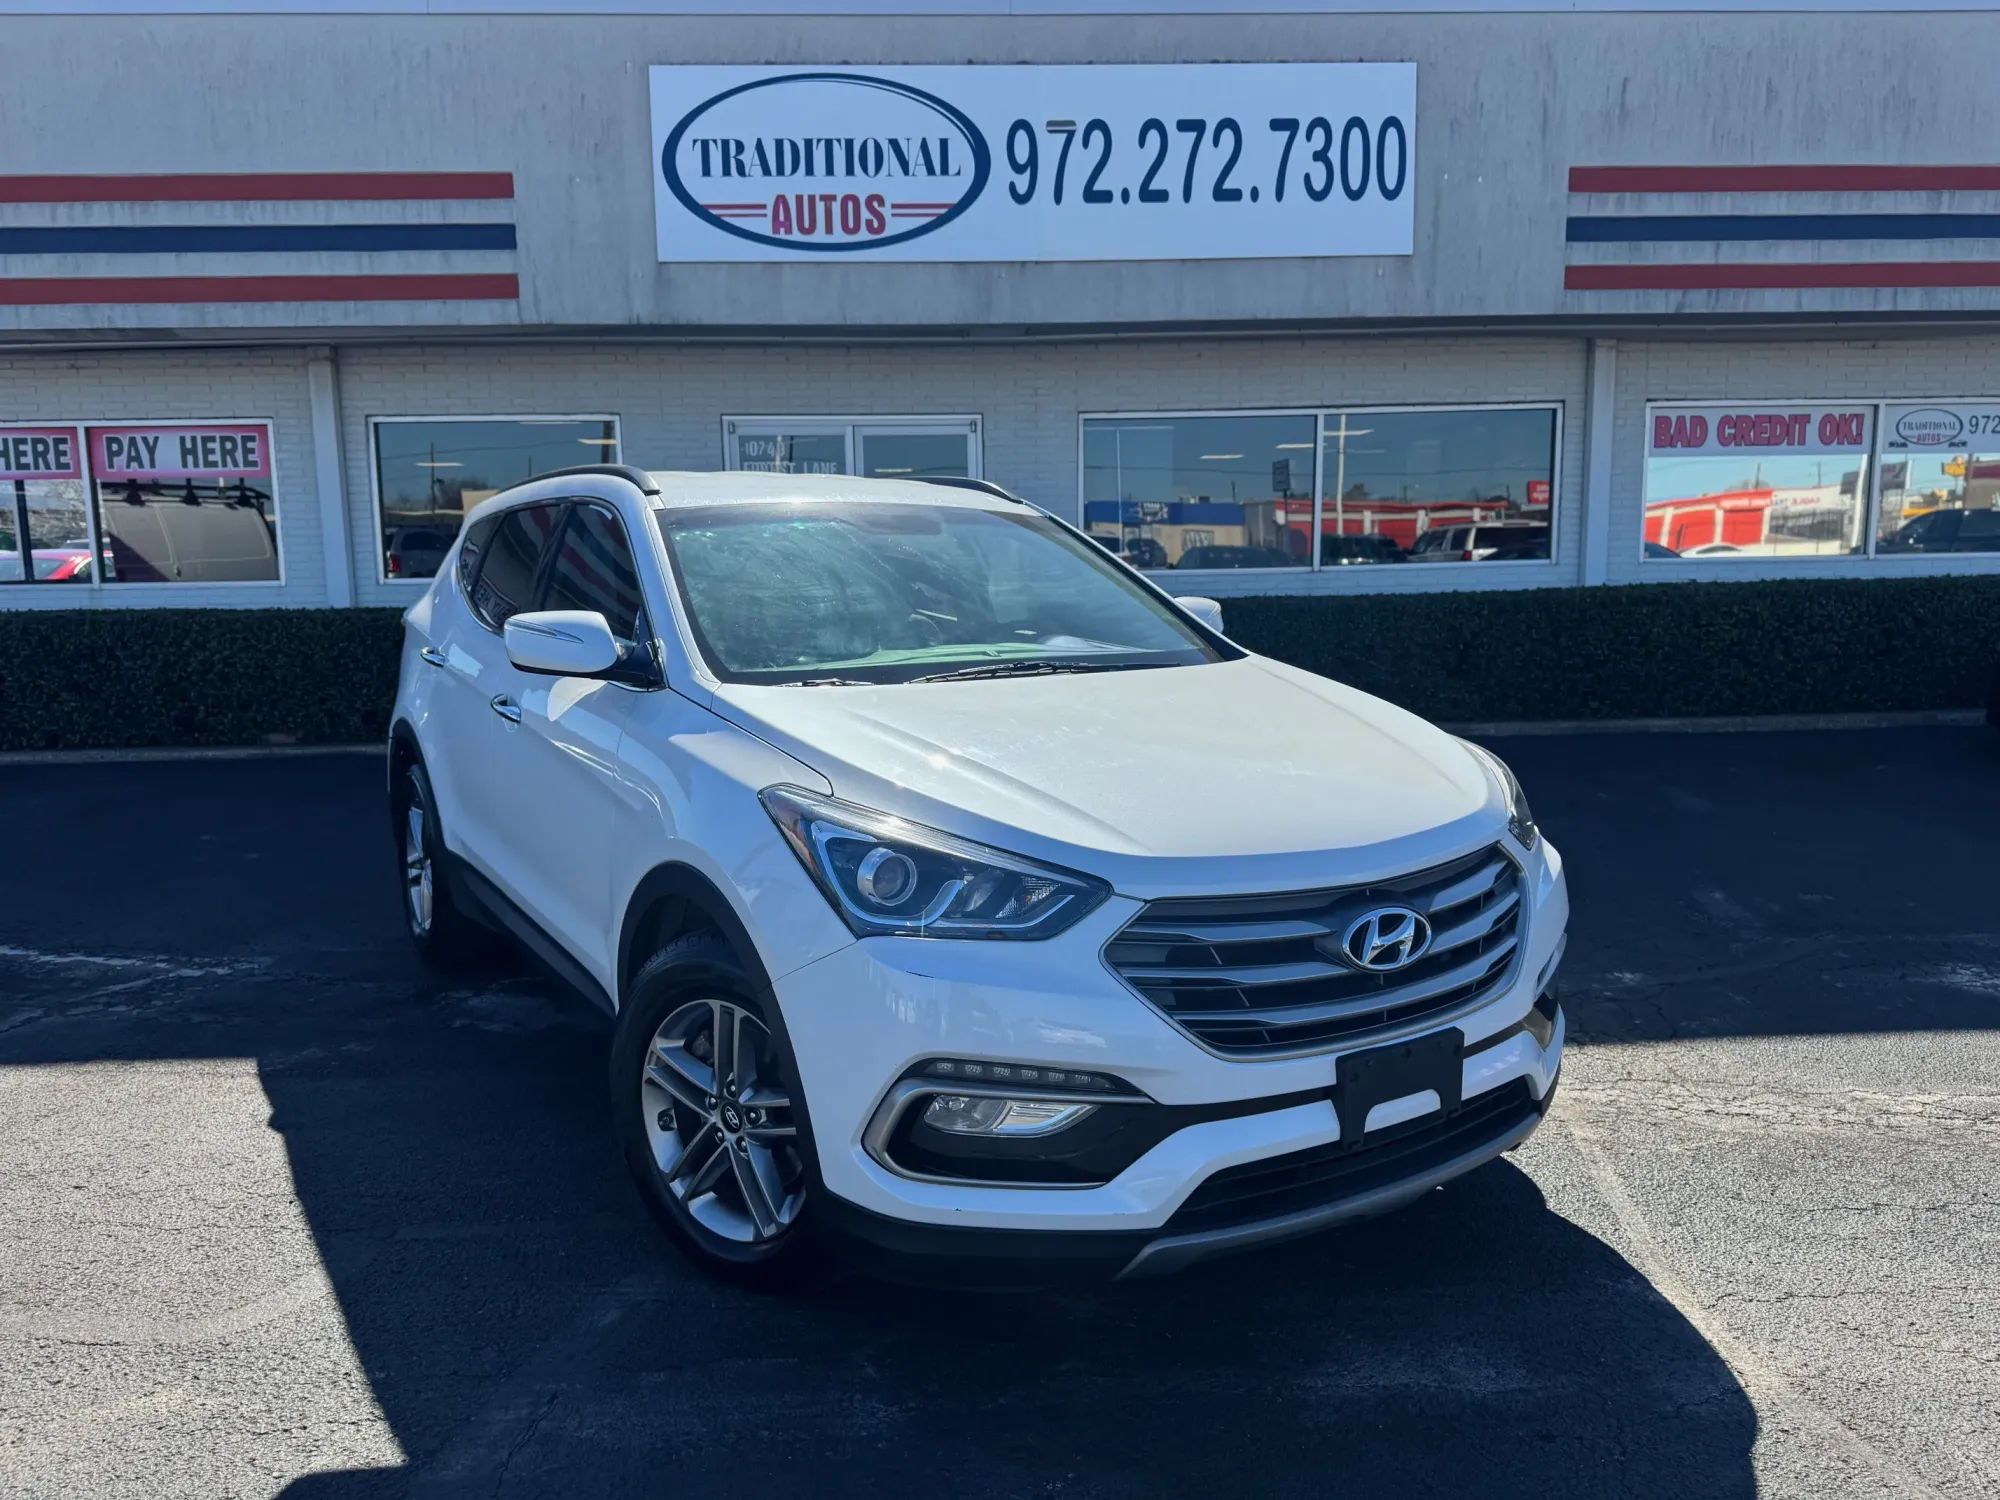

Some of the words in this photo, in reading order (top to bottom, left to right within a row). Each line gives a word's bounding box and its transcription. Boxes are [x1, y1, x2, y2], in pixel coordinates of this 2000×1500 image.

[692, 137, 963, 178] TRADITIONAL
[1005, 115, 1408, 206] 972.272.7300
[771, 194, 886, 236] AUTOS
[1654, 415, 1709, 449] BAD
[1717, 414, 1811, 447] CREDIT
[1818, 413, 1866, 446] OK!
[1902, 421, 1957, 431] TRADITIONAL
[1916, 433, 1942, 443] AUTOS
[104, 435, 160, 471] PAY
[179, 434, 260, 470] HERE
